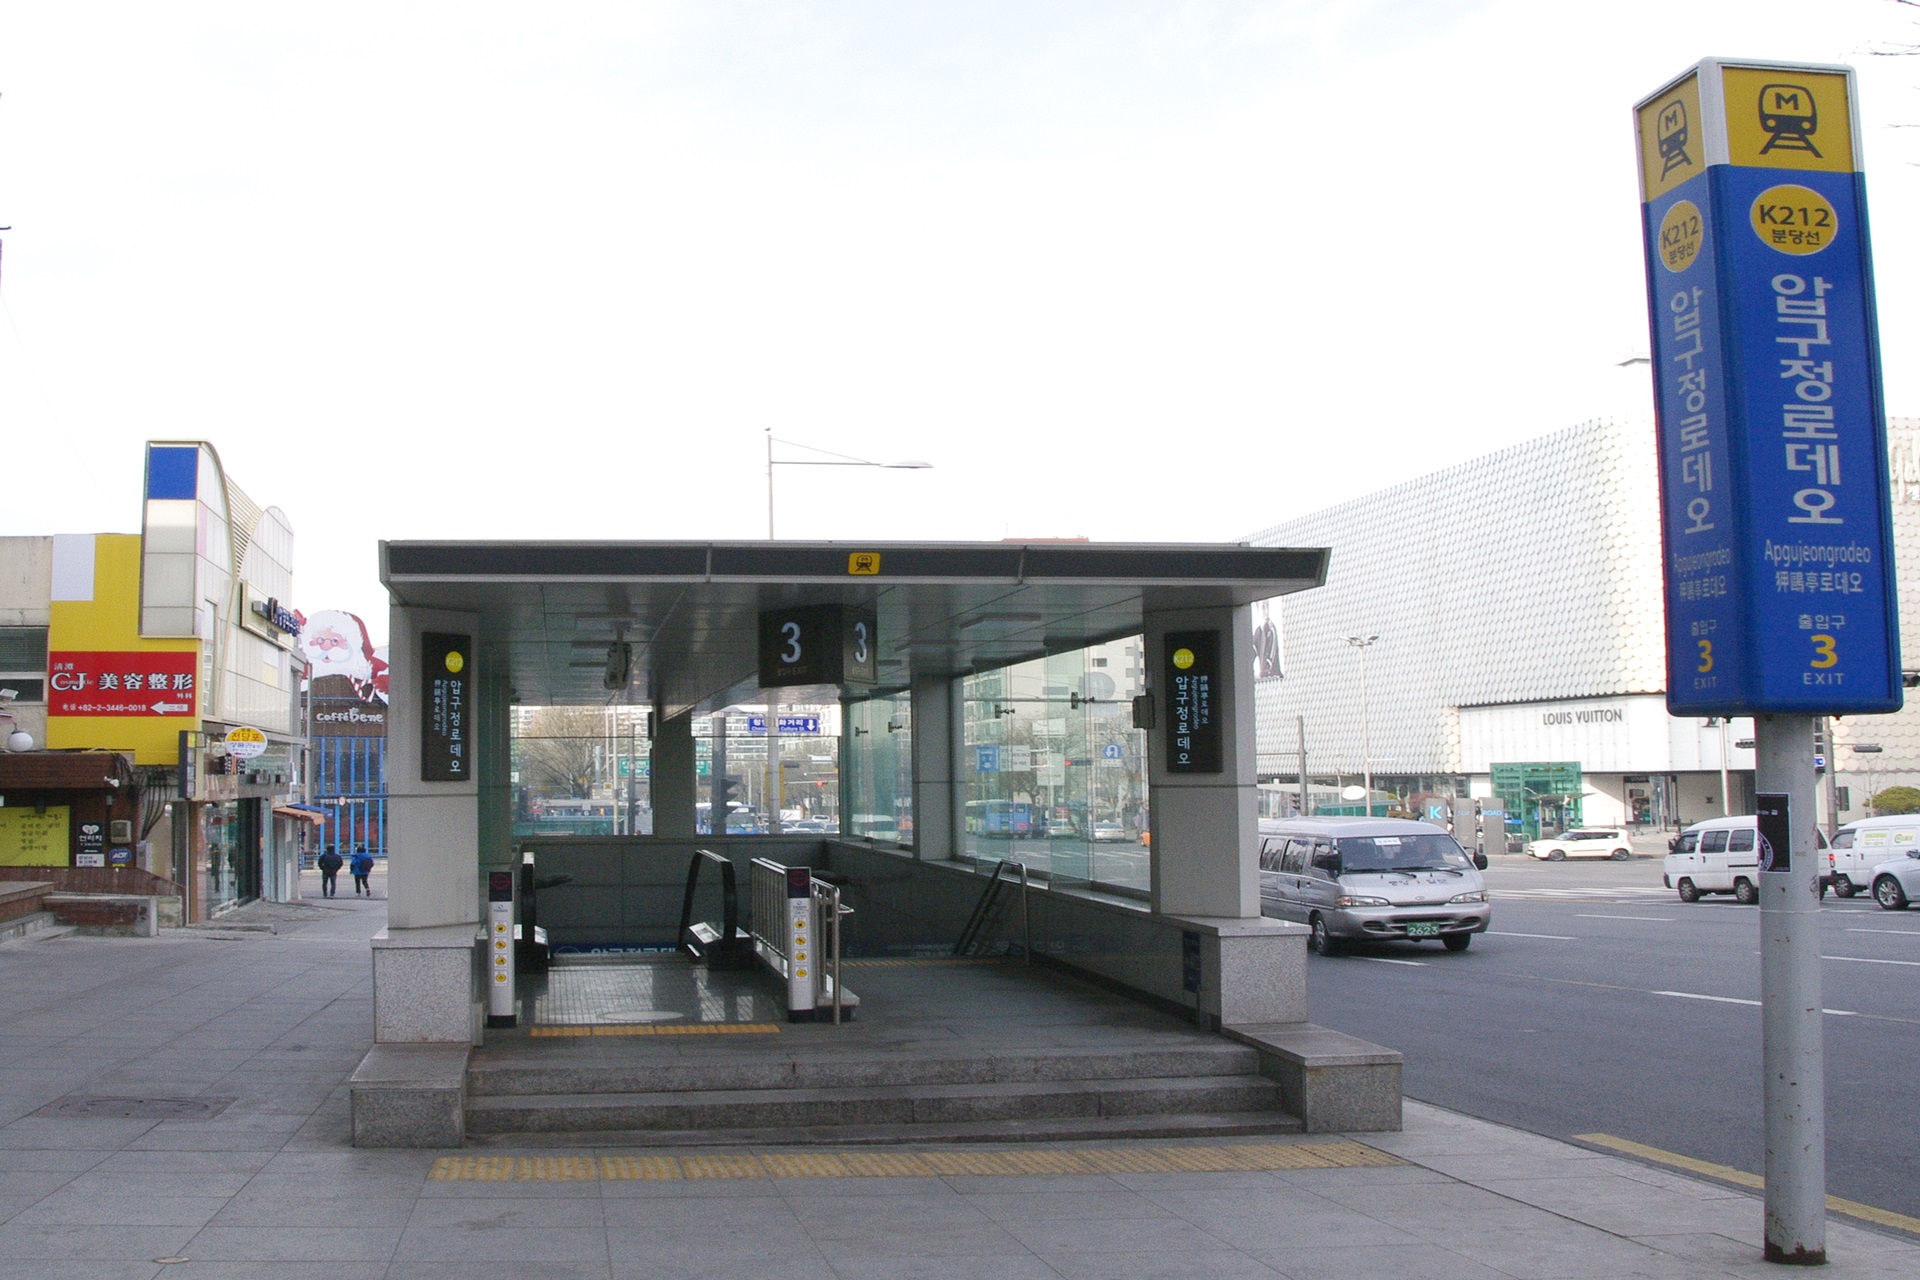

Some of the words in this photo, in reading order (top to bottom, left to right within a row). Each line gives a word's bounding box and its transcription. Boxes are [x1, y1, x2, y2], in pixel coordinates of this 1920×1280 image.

[1775, 93, 1799, 110] M
[1665, 110, 1678, 131] M
[1760, 205, 1830, 227] K212
[1663, 216, 1699, 248] K212
[1771, 229, 1820, 245] 분당선
[1669, 241, 1694, 265] 분당선
[1771, 274, 1844, 524] 압구정로데오
[1670, 285, 1715, 535] 압구정로데오
[1764, 539, 1871, 568] Apgujeongrodeo
[1798, 614, 1845, 630] 출입구
[781, 622, 801, 663] 3
[855, 622, 867, 663] 3
[1810, 634, 1838, 668] 3
[1173, 655, 1194, 664] K212
[1697, 639, 1714, 673] 3
[50, 672, 88, 691] CJ
[99, 673, 193, 690] 美容整形
[1694, 676, 1717, 690] EXIT
[1803, 673, 1844, 685] EXIT
[77, 704, 147, 712] +82-2-3446-0018
[1543, 712, 1572, 726] LOUIS
[1575, 709, 1622, 724] VUITTON
[450, 680, 462, 772] 압구정로데오
[1175, 676, 1191, 764] 압구정로데오
[231, 732, 260, 742] 전당포
[1429, 805, 1443, 819] K
[1482, 809, 1503, 817] ROAD
[1409, 927, 1438, 936] 2623
